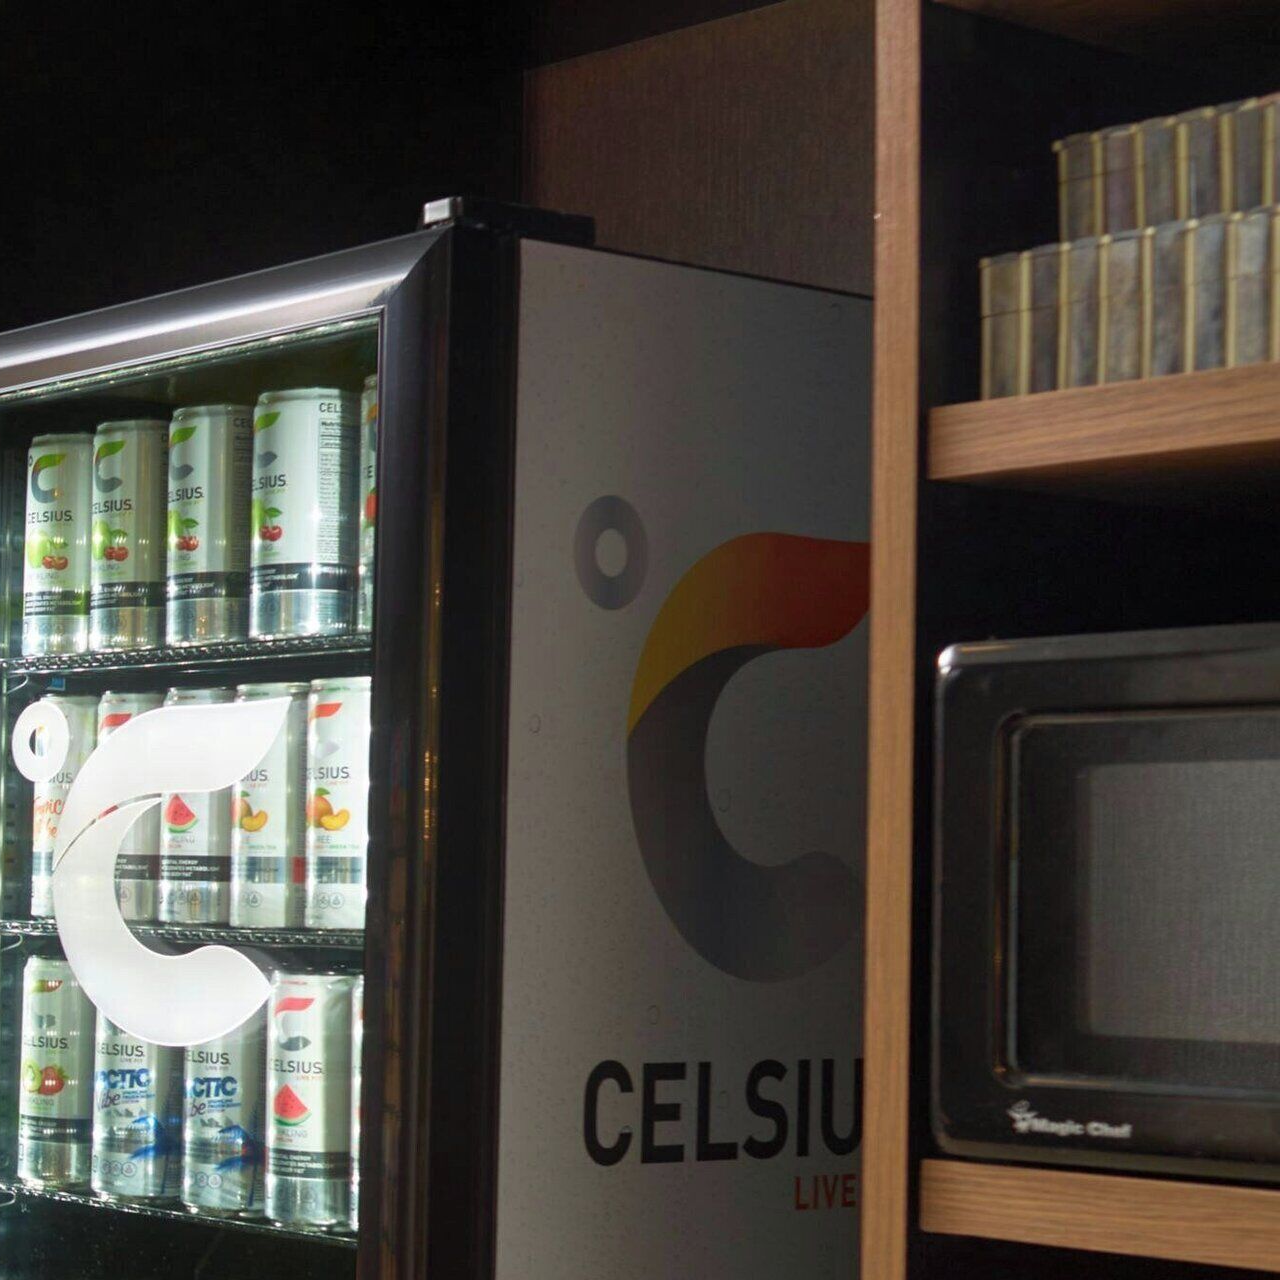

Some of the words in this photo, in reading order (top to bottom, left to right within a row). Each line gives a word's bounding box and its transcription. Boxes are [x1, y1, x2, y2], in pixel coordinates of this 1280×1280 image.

[583, 1058, 865, 1166] CELSIU
[1030, 1117, 1085, 1136] Magic
[1087, 1121, 1133, 1138] Chef
[795, 1174, 857, 1211] LIVE
